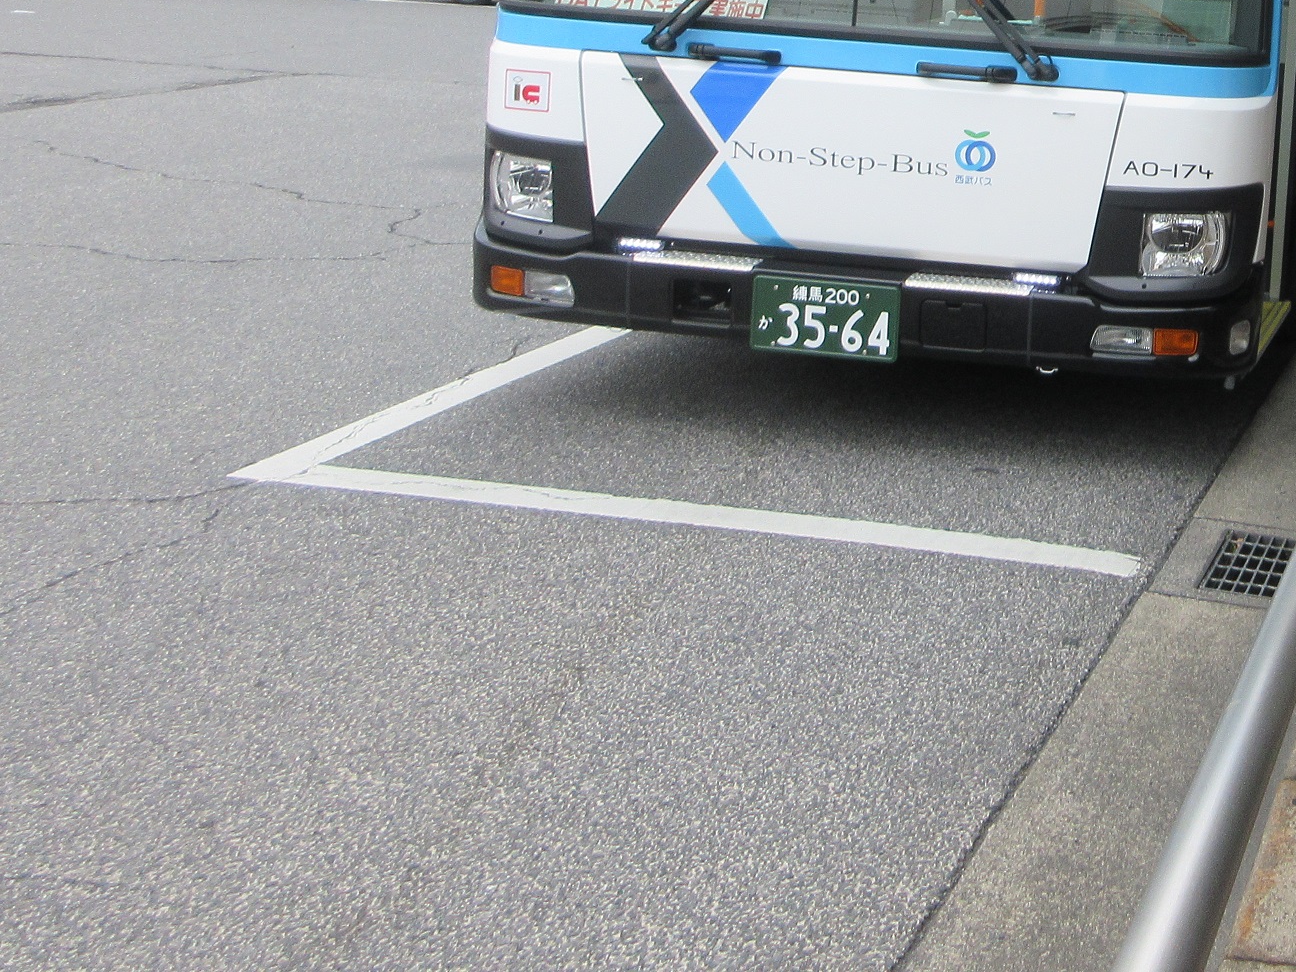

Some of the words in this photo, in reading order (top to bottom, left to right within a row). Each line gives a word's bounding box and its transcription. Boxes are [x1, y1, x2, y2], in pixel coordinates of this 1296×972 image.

[731, 140, 949, 177] Non-Step-Bus
[955, 174, 993, 186] 西武バス
[758, 314, 773, 331] か
[776, 302, 890, 356] 35-64
